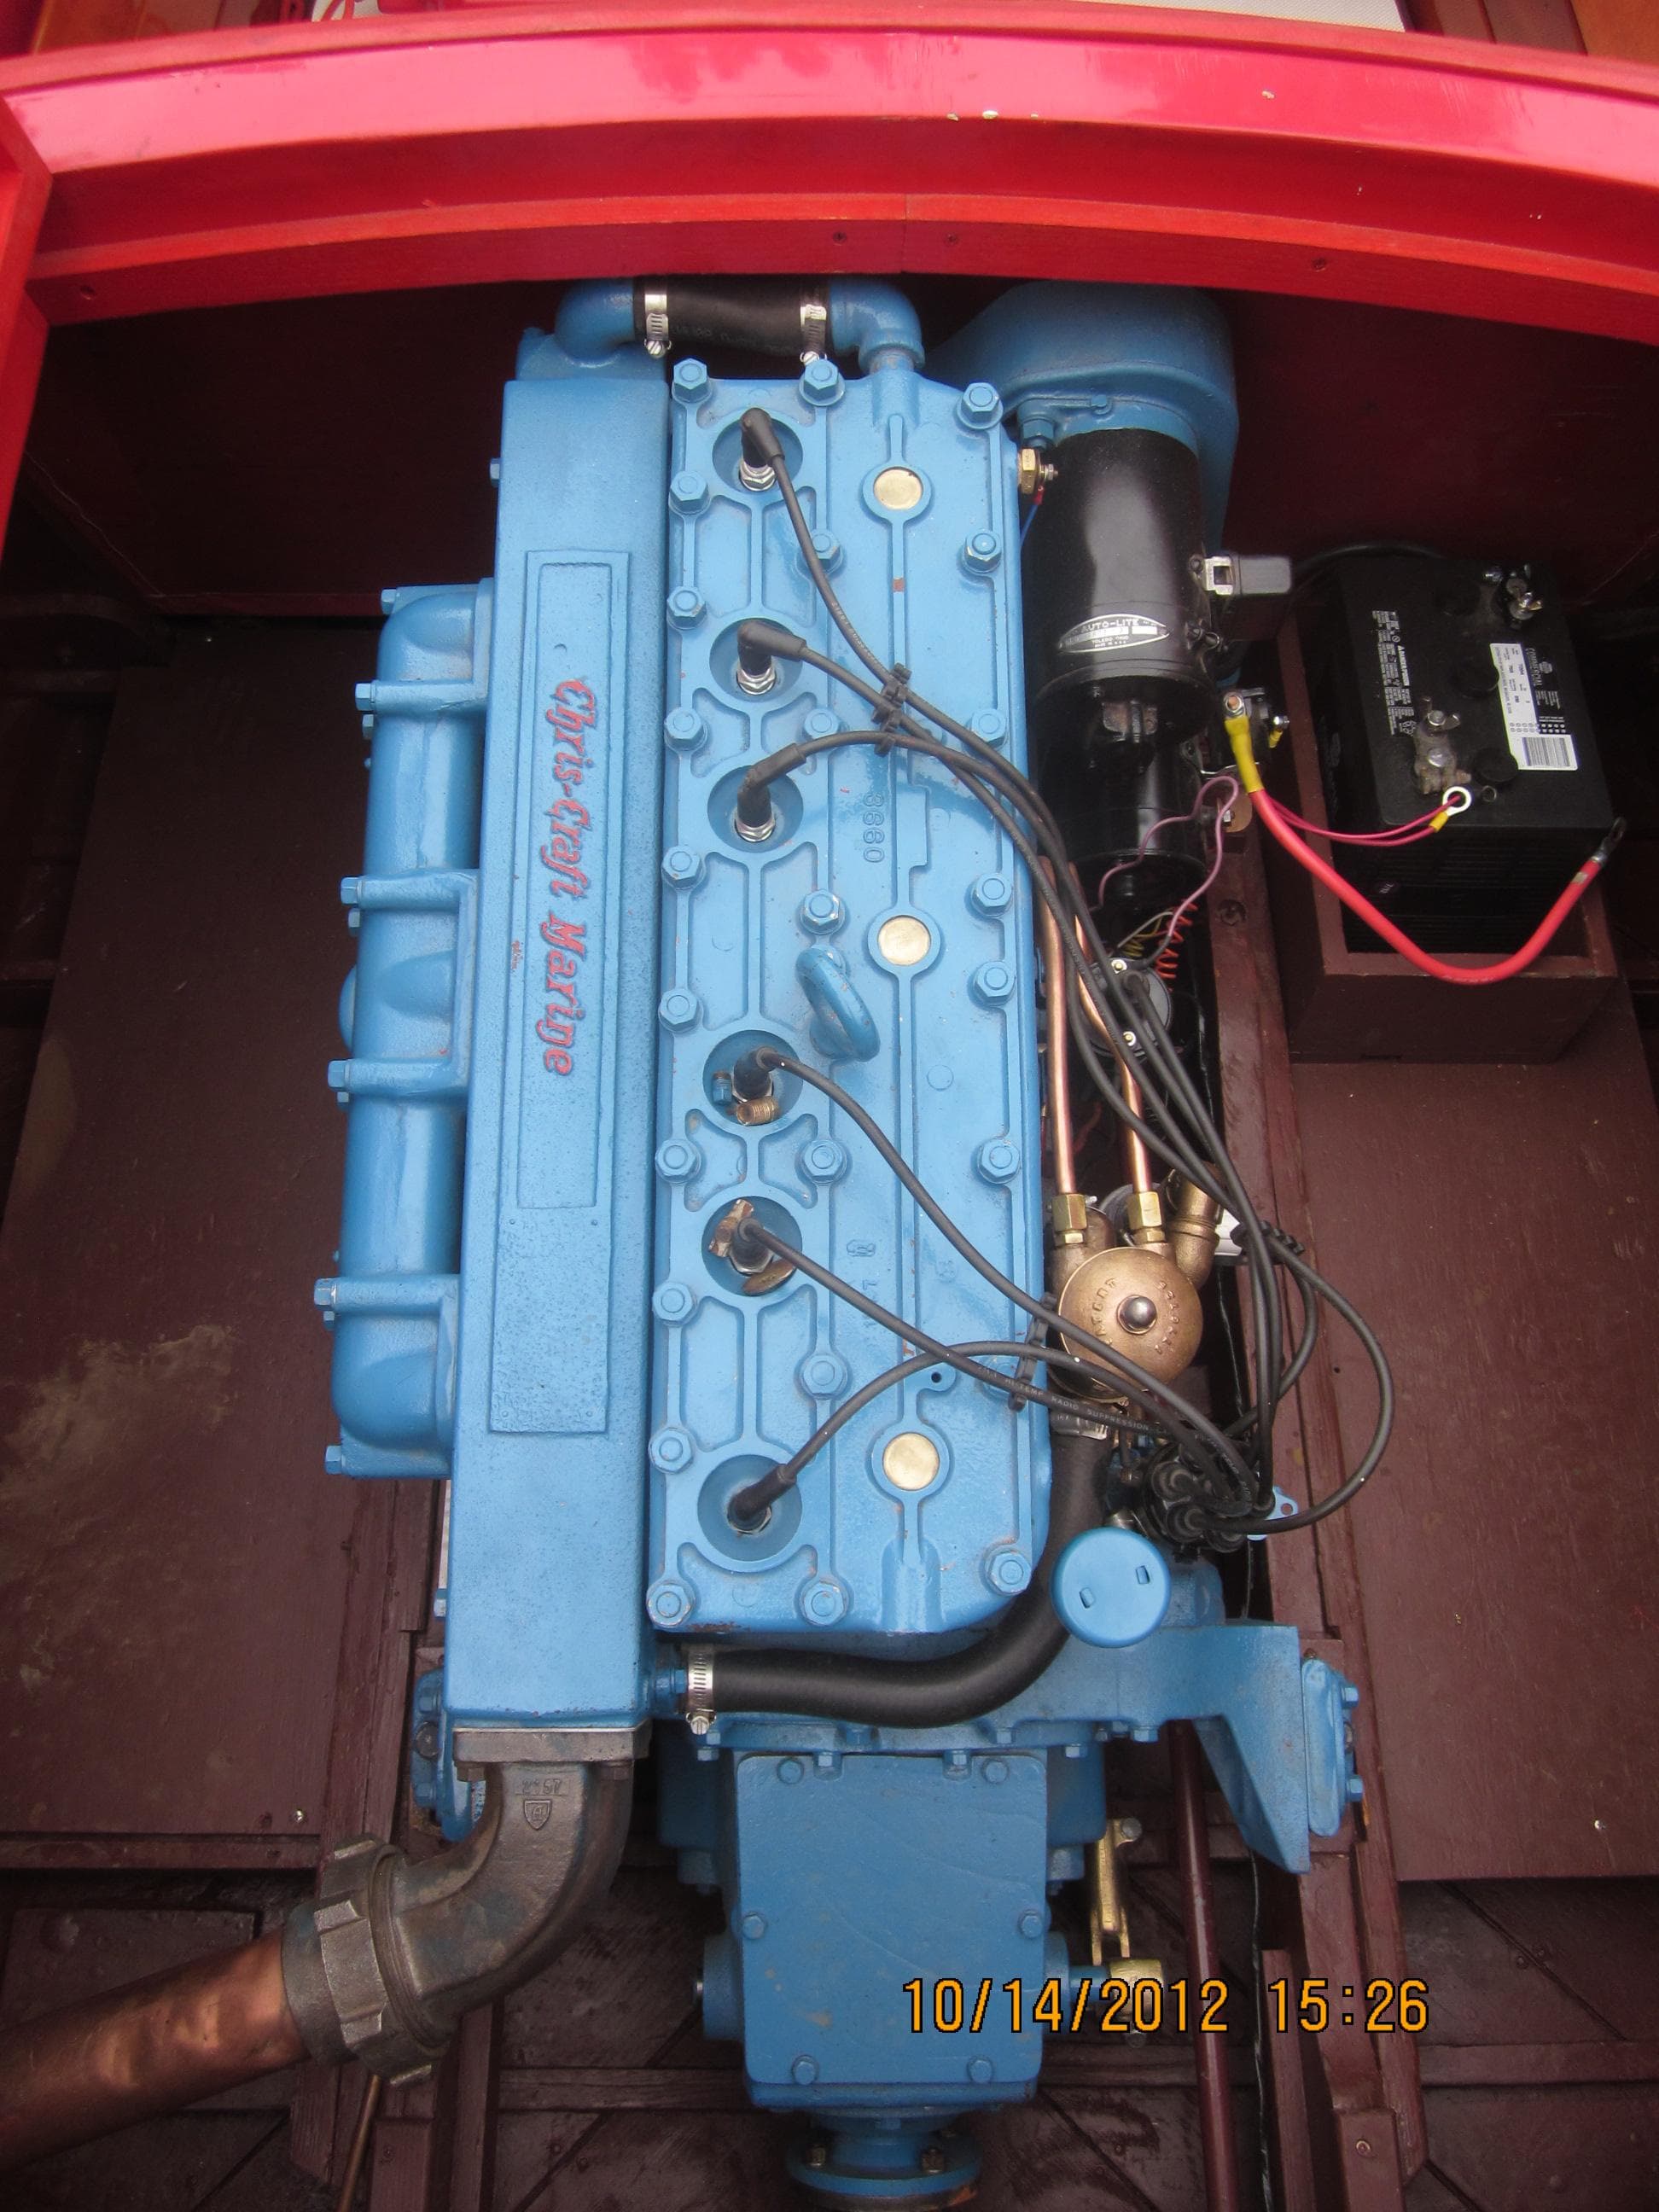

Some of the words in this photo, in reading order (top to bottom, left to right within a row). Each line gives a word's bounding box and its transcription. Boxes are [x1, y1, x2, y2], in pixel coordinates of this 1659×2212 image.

[1080, 618, 1139, 633] AUTO-LITE
[540, 677, 598, 899] Chris-Craft
[534, 910, 589, 1078] Marine
[1051, 1395, 1080, 1411] RADIO
[1087, 1408, 1149, 1431] SUPPRESSION
